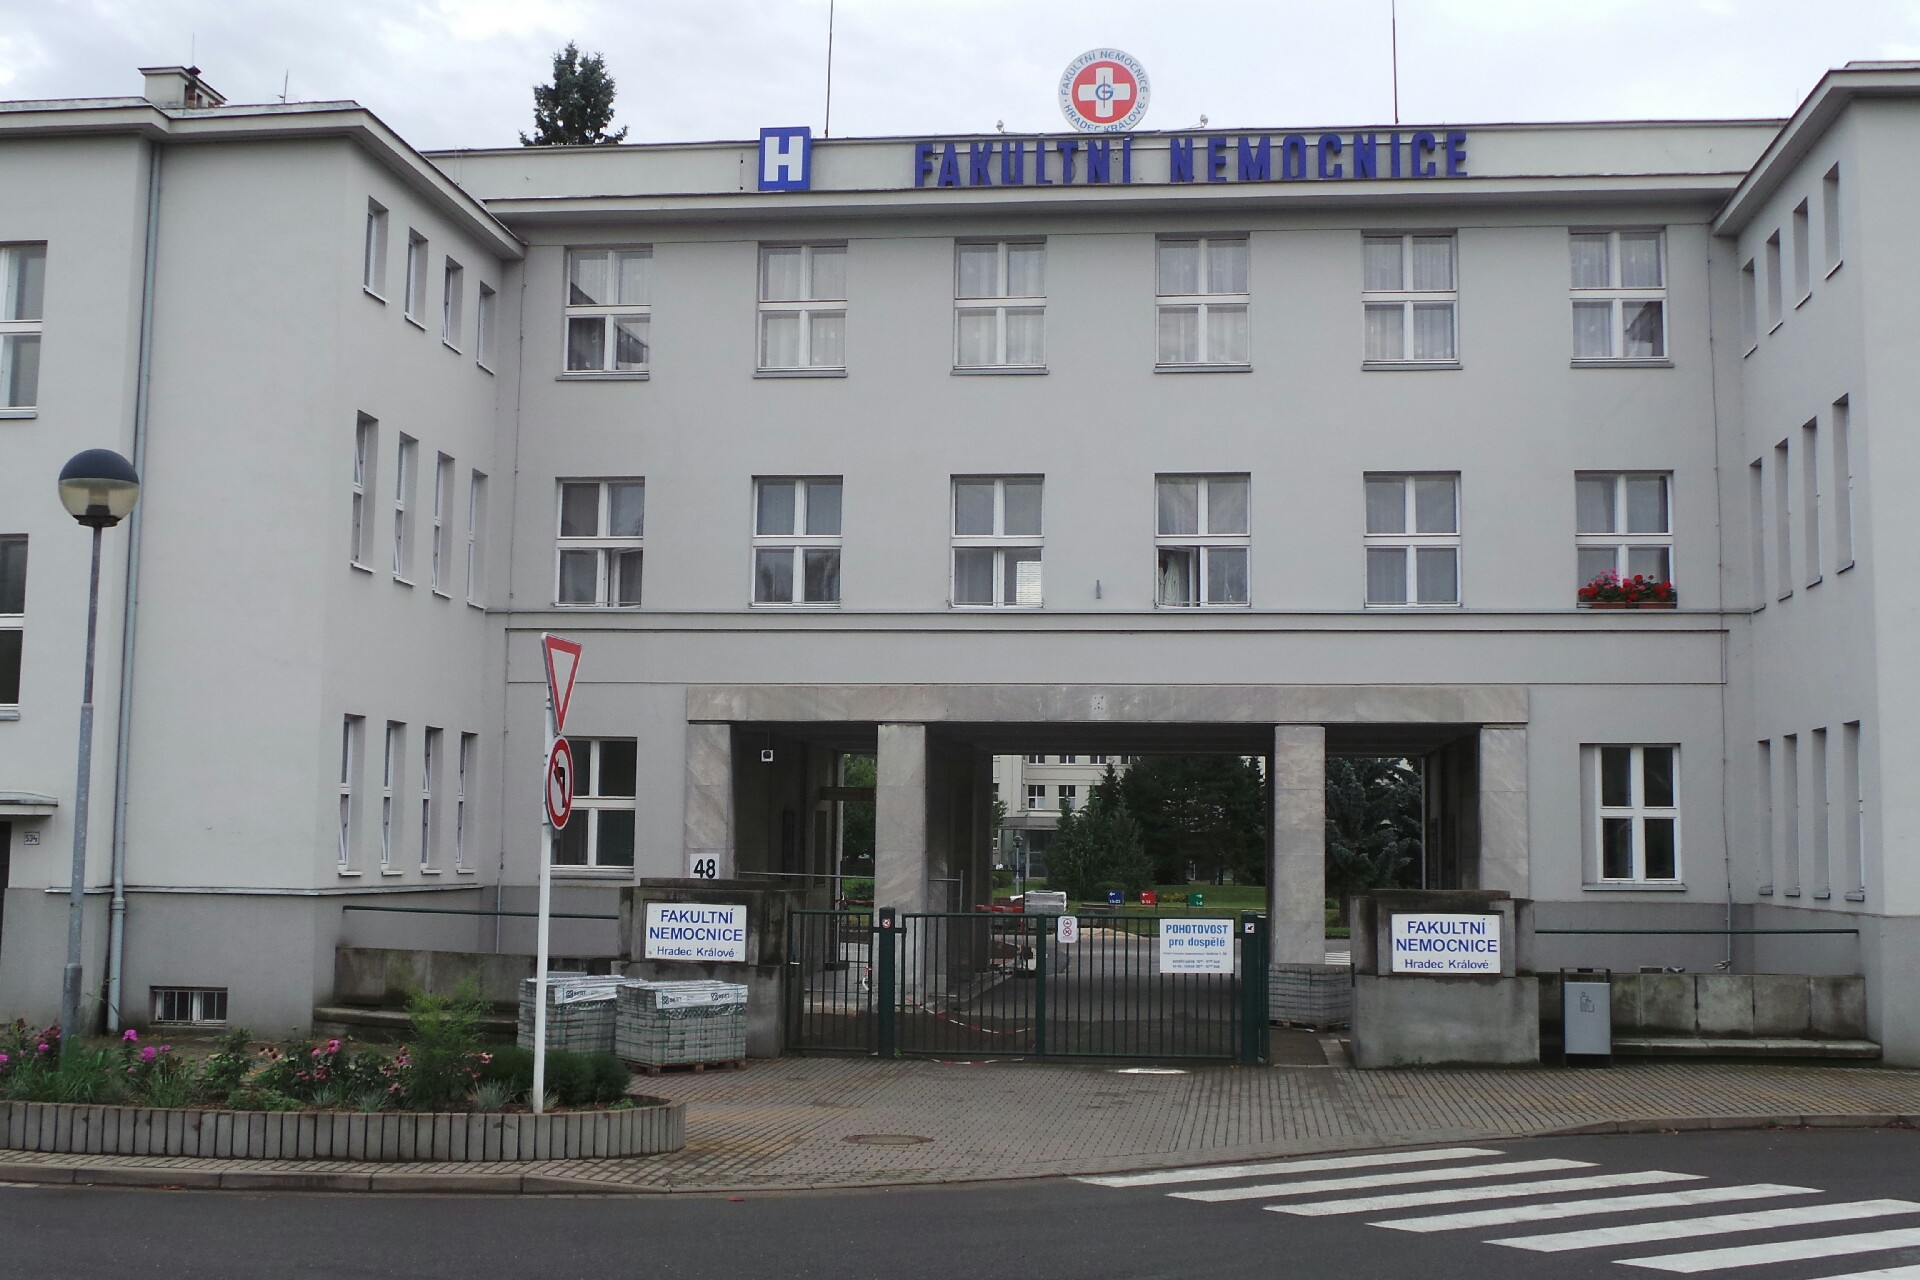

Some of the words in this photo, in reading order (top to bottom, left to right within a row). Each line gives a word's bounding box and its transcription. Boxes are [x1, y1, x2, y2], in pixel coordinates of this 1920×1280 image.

[1100, 50, 1149, 94] NEMOCNICE
[763, 135, 804, 182] H
[1170, 131, 1467, 183] NEMOCNICE
[693, 858, 716, 879] 48
[660, 908, 734, 924] FAKULTNÍ
[1166, 924, 1229, 934] POHOTOVOST
[1407, 918, 1486, 935] FAKULTNÍ
[649, 927, 743, 942] NEMOCNICE
[1168, 938, 1184, 949] pro
[1187, 936, 1226, 949] dospělé
[1396, 938, 1498, 953] NEMOCNICE
[656, 946, 692, 957] Hradec
[696, 947, 735, 958] Králové
[1404, 959, 1444, 969] Hradec
[1448, 959, 1489, 969] Králové
